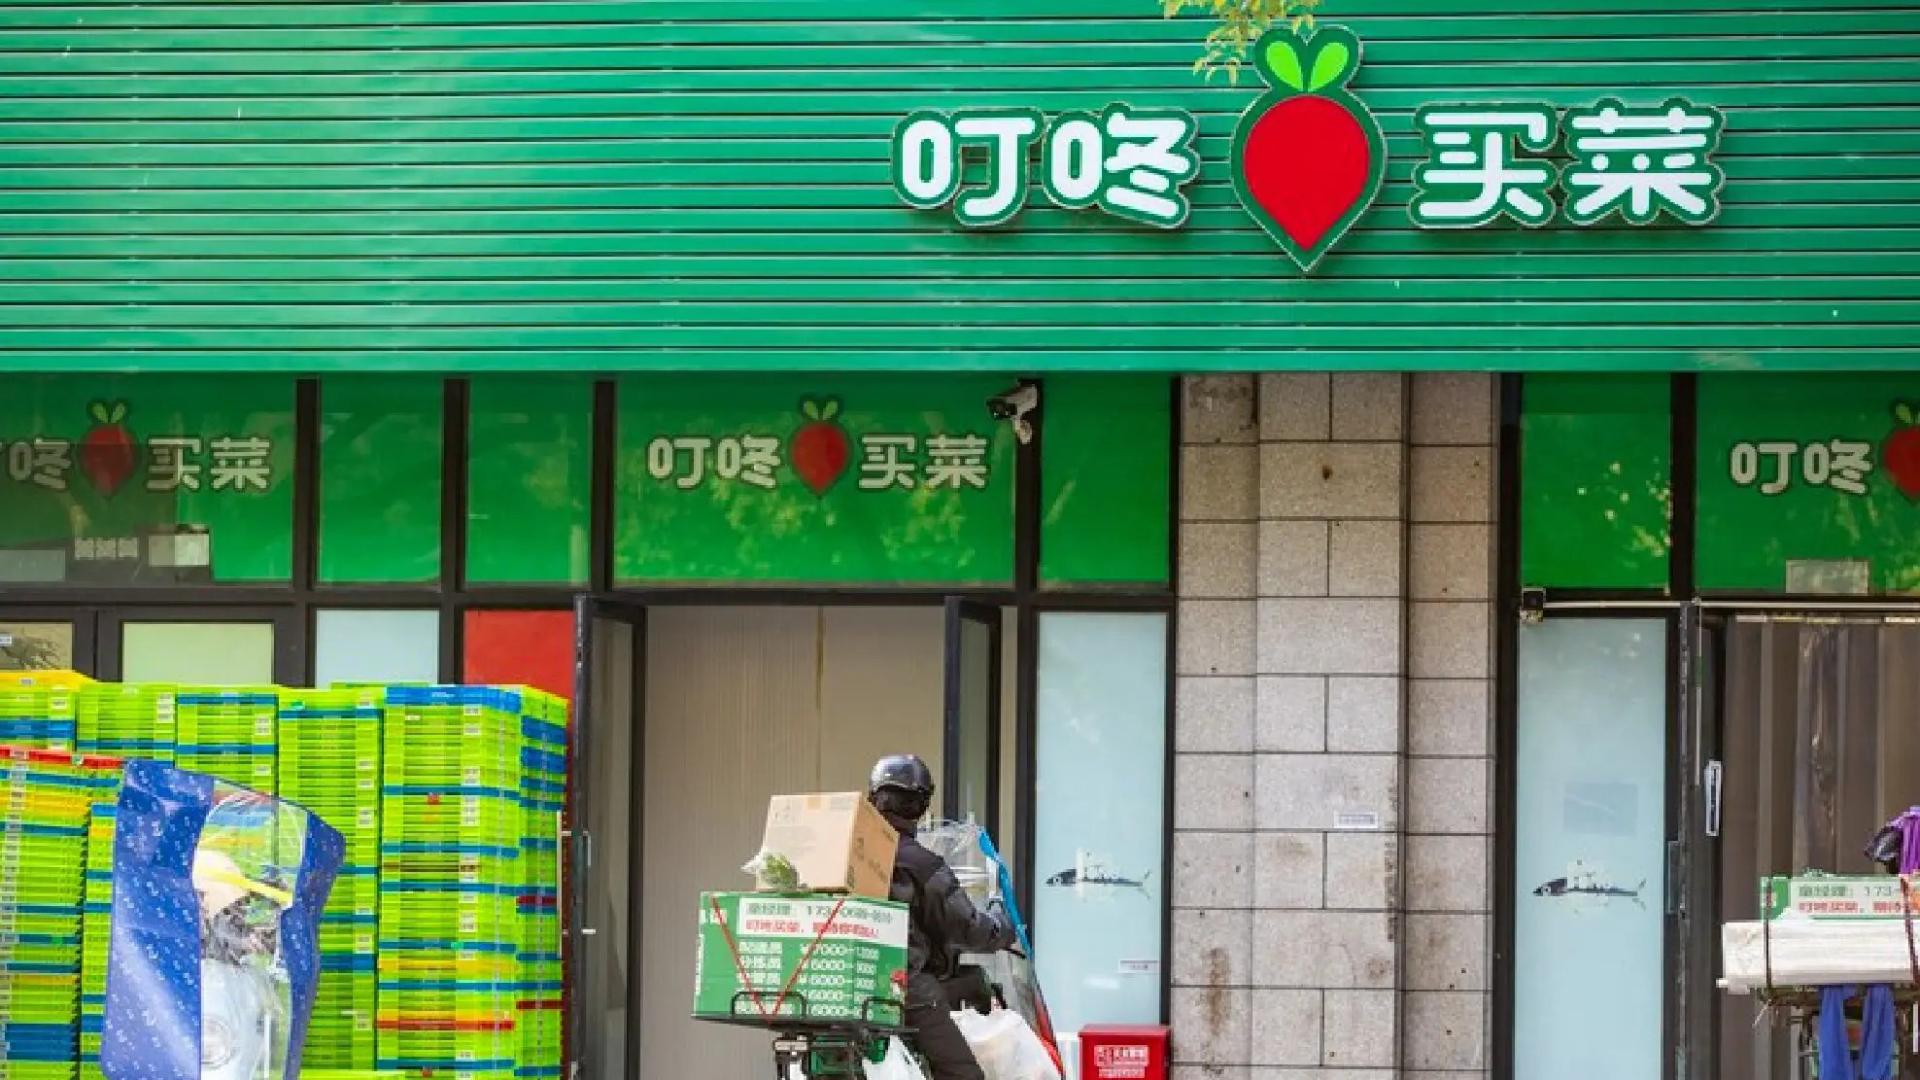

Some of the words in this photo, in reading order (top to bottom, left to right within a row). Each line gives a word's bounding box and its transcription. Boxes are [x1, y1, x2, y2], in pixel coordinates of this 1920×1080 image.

[902, 111, 1190, 218] 叮咚
[1418, 107, 1715, 217] 买菜
[0, 437, 71, 489] 咚
[147, 436, 270, 489] 买菜
[647, 434, 781, 489] 叮咚
[858, 434, 988, 489] 买菜
[1730, 438, 1873, 494] 叮咚
